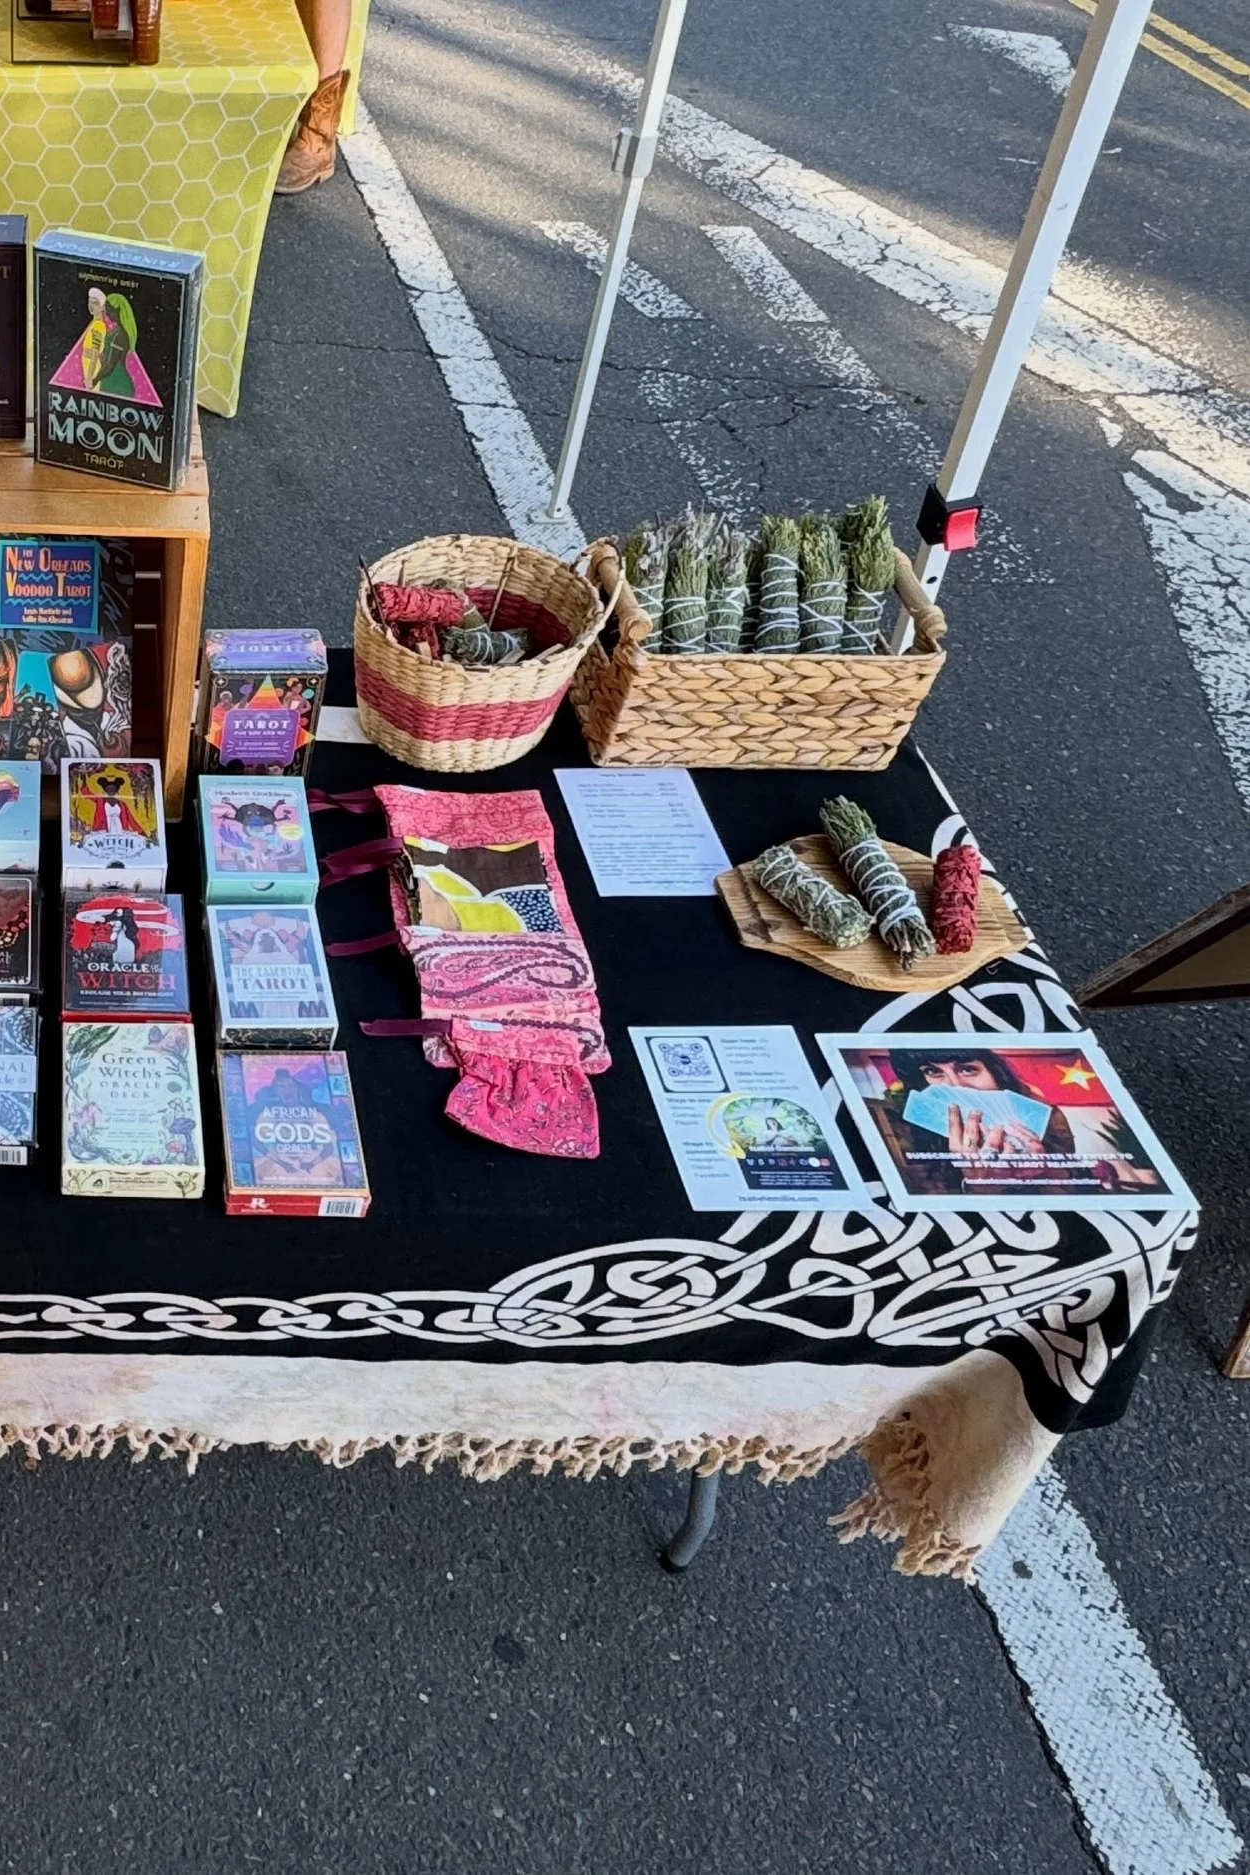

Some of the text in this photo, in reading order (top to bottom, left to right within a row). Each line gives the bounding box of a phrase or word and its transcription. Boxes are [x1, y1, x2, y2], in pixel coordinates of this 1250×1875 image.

[48, 391, 164, 432] RAINBOW
[48, 417, 164, 464] MOON
[83, 452, 125, 470] TAROT
[5, 546, 92, 572] NEW ORLEANS
[5, 571, 92, 597] VOODOO TAROT
[234, 720, 291, 729] TAROT
[93, 838, 134, 849] WITCH
[87, 962, 151, 973] ORACLE
[77, 971, 177, 990] WITCH
[238, 978, 310, 990] TAROT
[102, 1052, 157, 1065] Green
[98, 1066, 163, 1079] Witch's
[100, 1081, 160, 1089] ORACLE
[110, 1091, 151, 1099] DECK
[263, 1105, 318, 1119] AFRICAN
[255, 1122, 331, 1144] GODS
[276, 1143, 312, 1152] ORACLE
